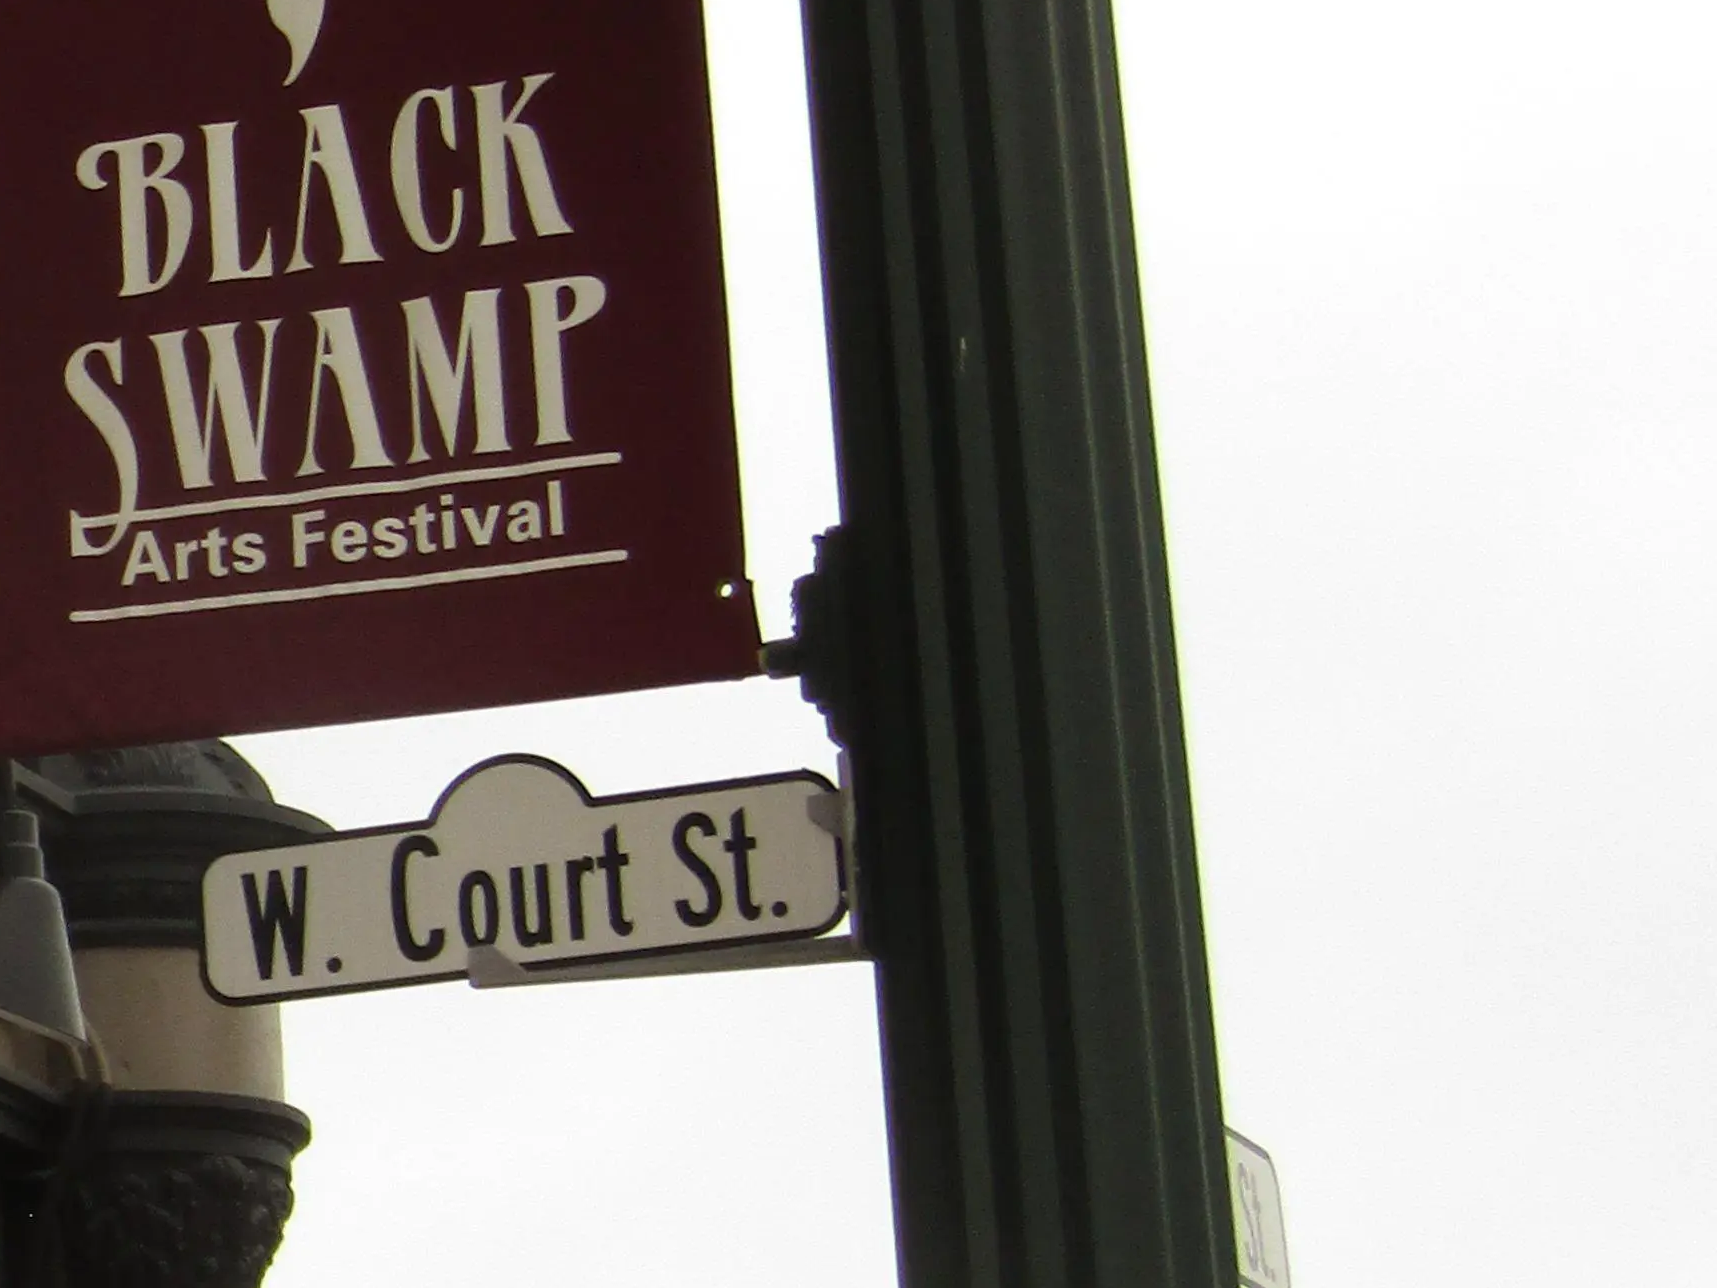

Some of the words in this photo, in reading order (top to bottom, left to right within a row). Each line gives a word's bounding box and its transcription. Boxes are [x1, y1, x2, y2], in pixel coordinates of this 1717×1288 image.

[75, 72, 575, 298] BLACK
[64, 274, 608, 558] SWAMP
[120, 525, 267, 586] Arts
[292, 480, 566, 568] Festival
[240, 864, 343, 981] W.
[389, 822, 634, 962] Court
[671, 806, 789, 928] St.
